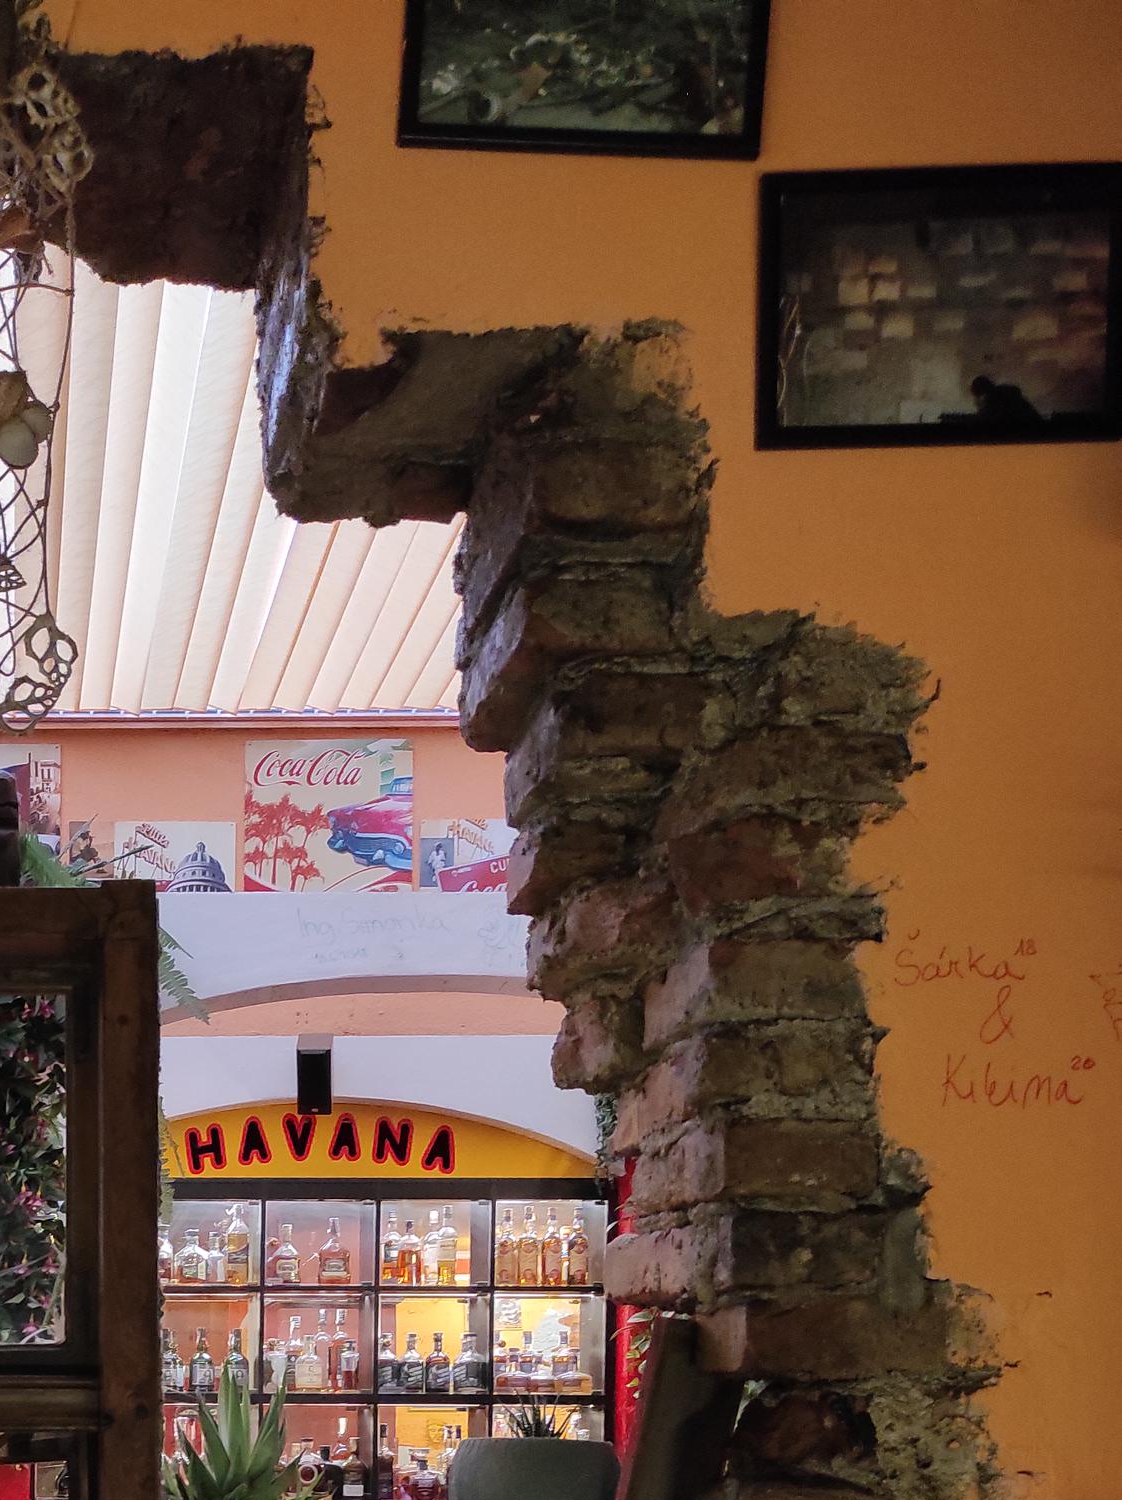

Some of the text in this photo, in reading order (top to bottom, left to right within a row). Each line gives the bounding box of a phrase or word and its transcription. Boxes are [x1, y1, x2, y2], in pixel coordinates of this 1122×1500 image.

[490, 858, 510, 873] CU
[979, 984, 1014, 1045] &
[185, 1113, 455, 1175] HAVANA
